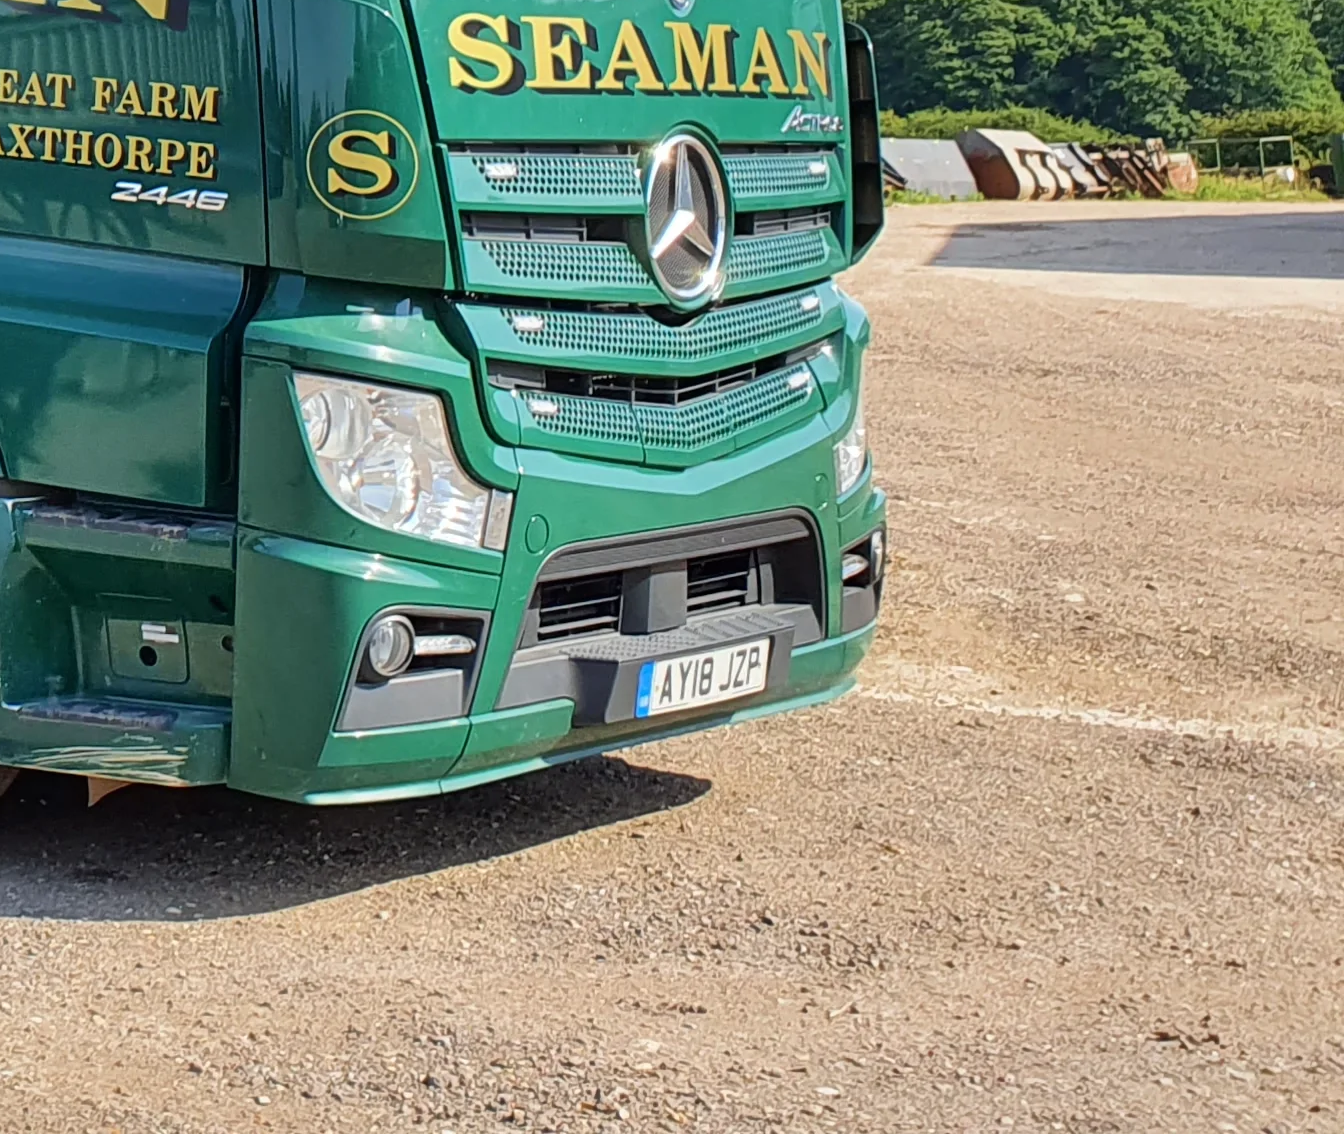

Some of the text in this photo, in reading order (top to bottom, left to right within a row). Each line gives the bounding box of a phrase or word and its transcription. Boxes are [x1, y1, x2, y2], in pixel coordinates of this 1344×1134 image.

[447, 13, 830, 99] SEAMAN
[90, 76, 219, 122] FARM
[327, 129, 393, 195] S
[111, 181, 229, 211] 2446
[658, 646, 762, 705] AY18 JZP
